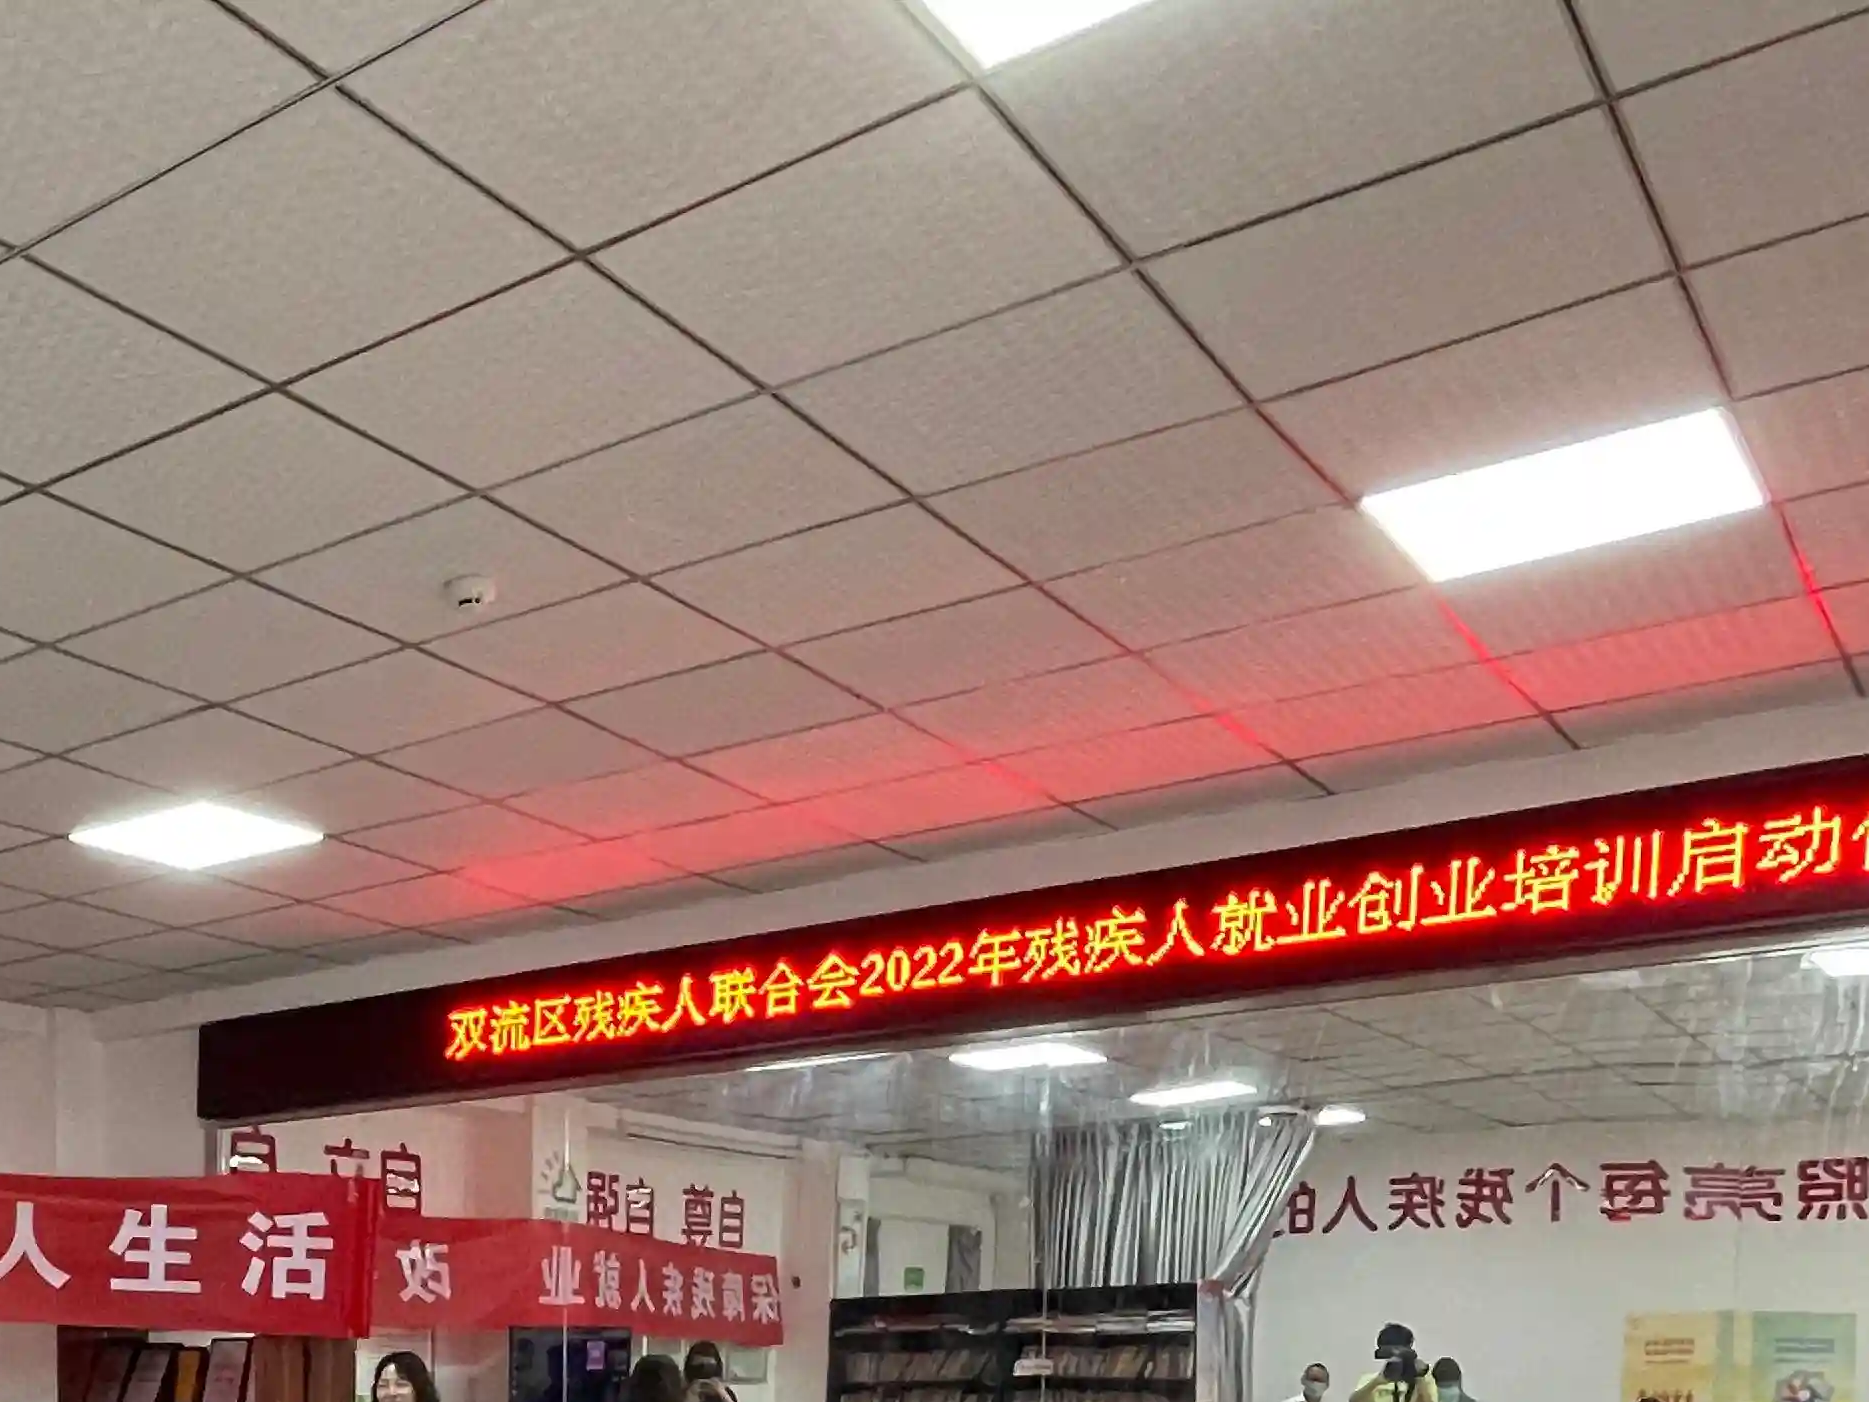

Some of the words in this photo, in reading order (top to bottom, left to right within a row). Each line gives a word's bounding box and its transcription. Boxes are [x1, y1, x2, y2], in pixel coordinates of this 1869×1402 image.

[445, 806, 1869, 1061] 双流区残疾人联合会2022年残疾人就业创业培训启动
